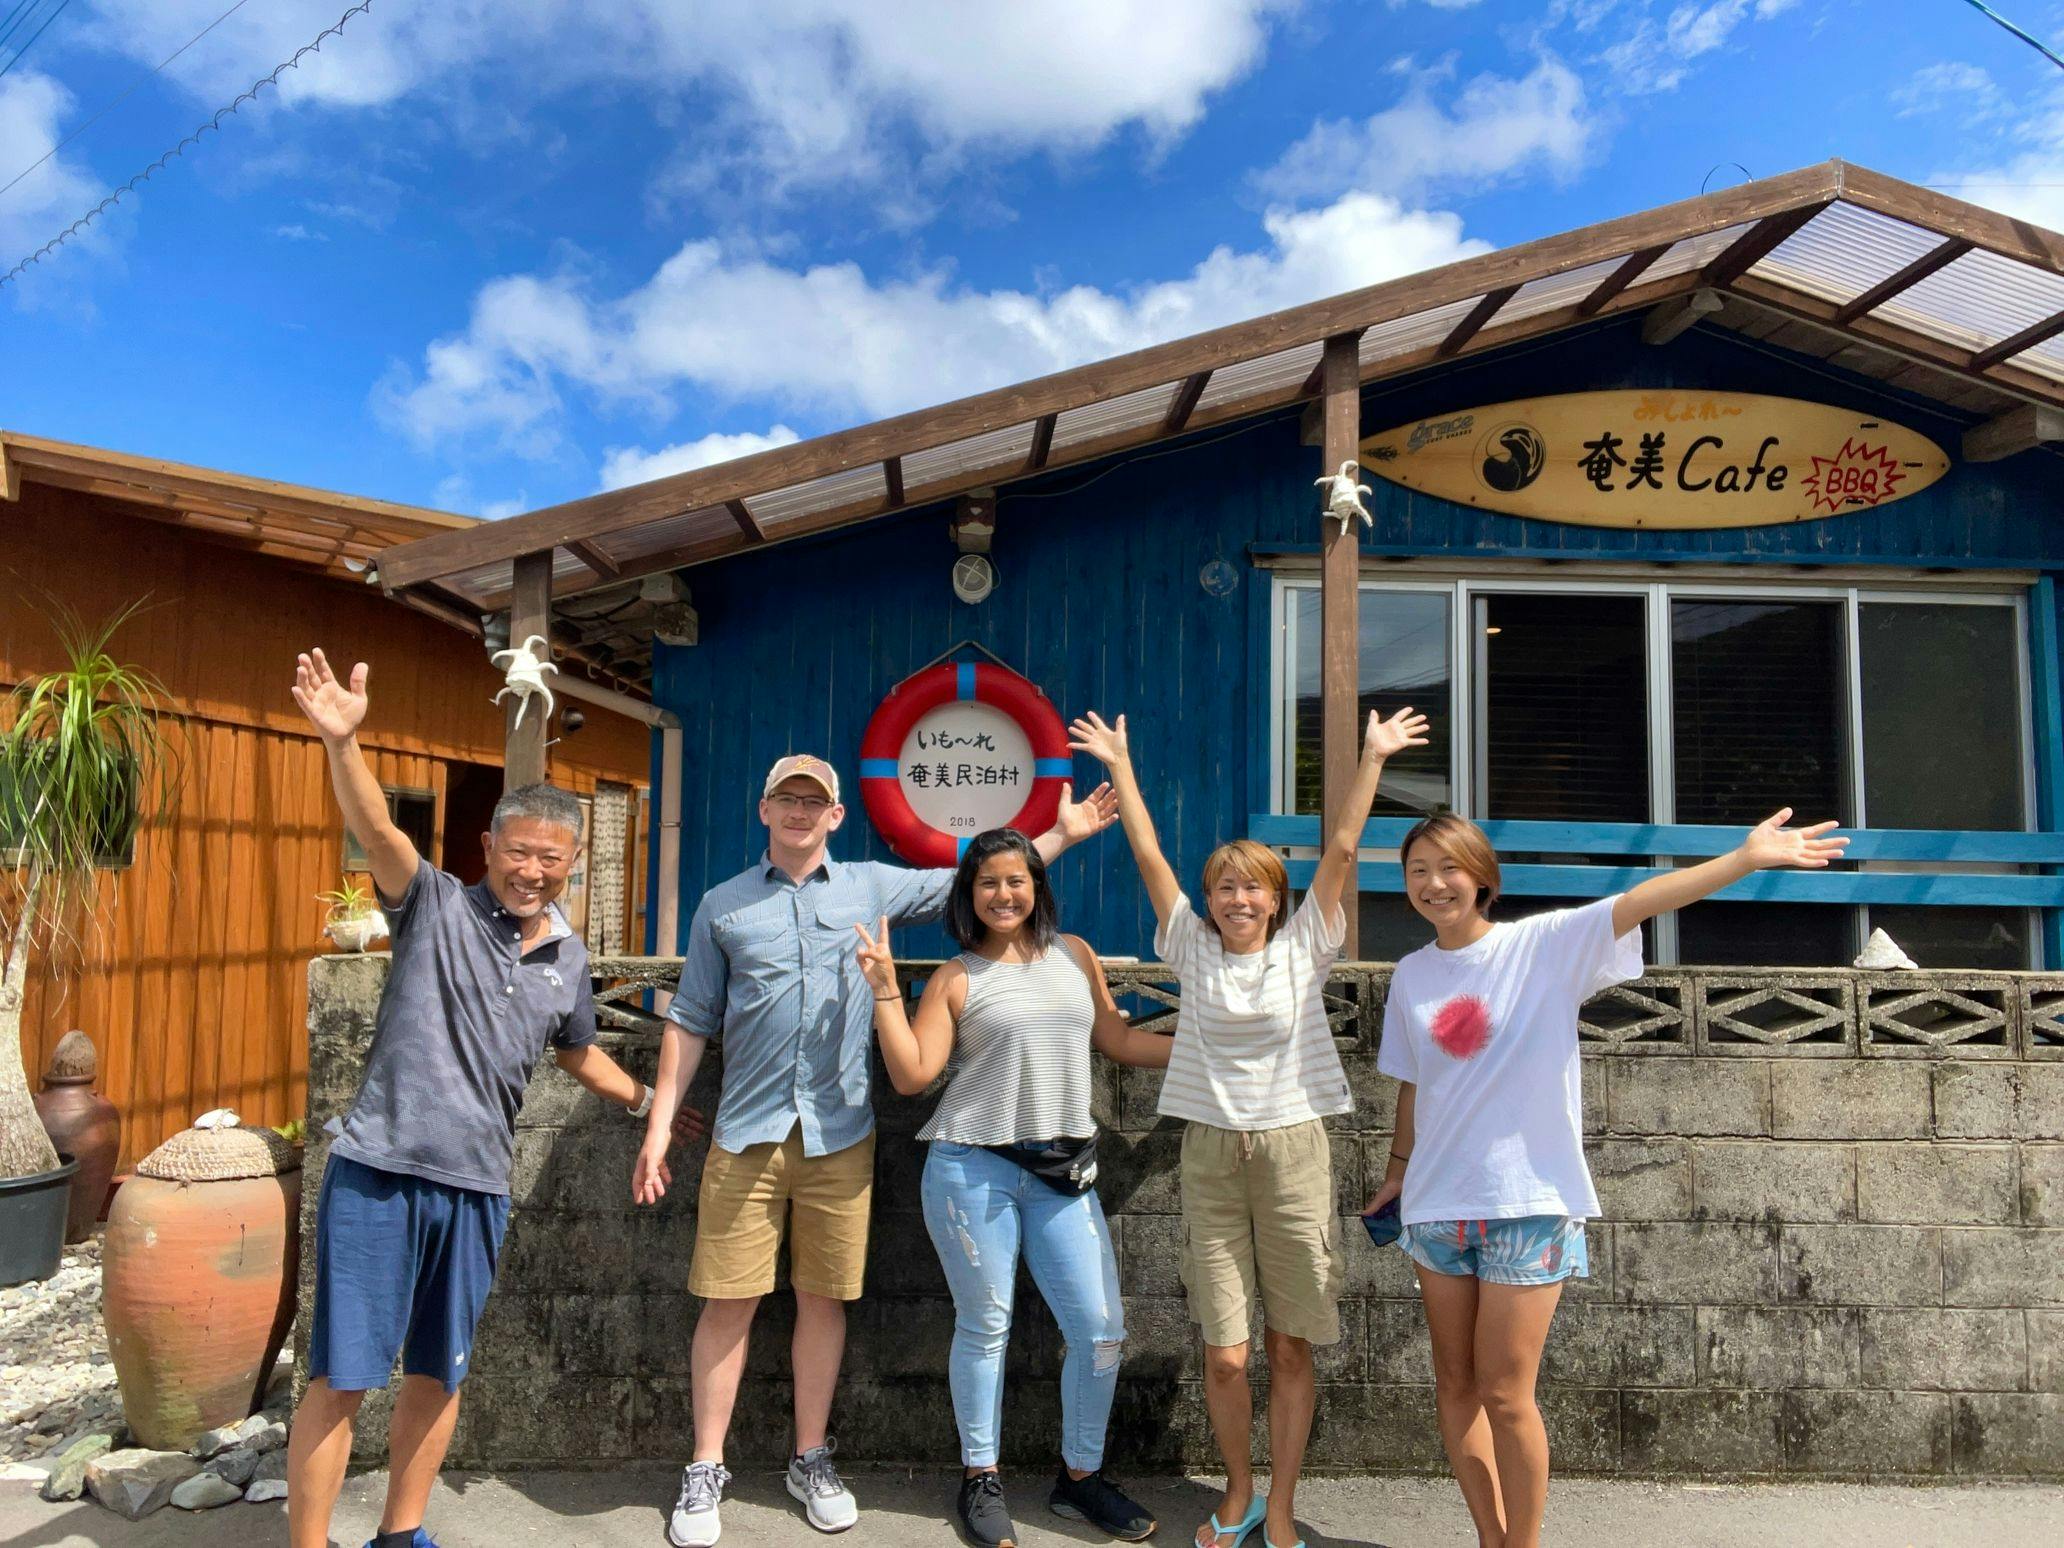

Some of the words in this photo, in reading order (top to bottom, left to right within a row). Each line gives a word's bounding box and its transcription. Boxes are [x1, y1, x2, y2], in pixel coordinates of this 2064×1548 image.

[1577, 431, 1666, 492] 奄美
[1677, 435, 1789, 493] Cafe
[1825, 467, 1880, 495] BBQ
[907, 763, 1020, 788] 奄美民泊村
[949, 816, 976, 828] 2018
